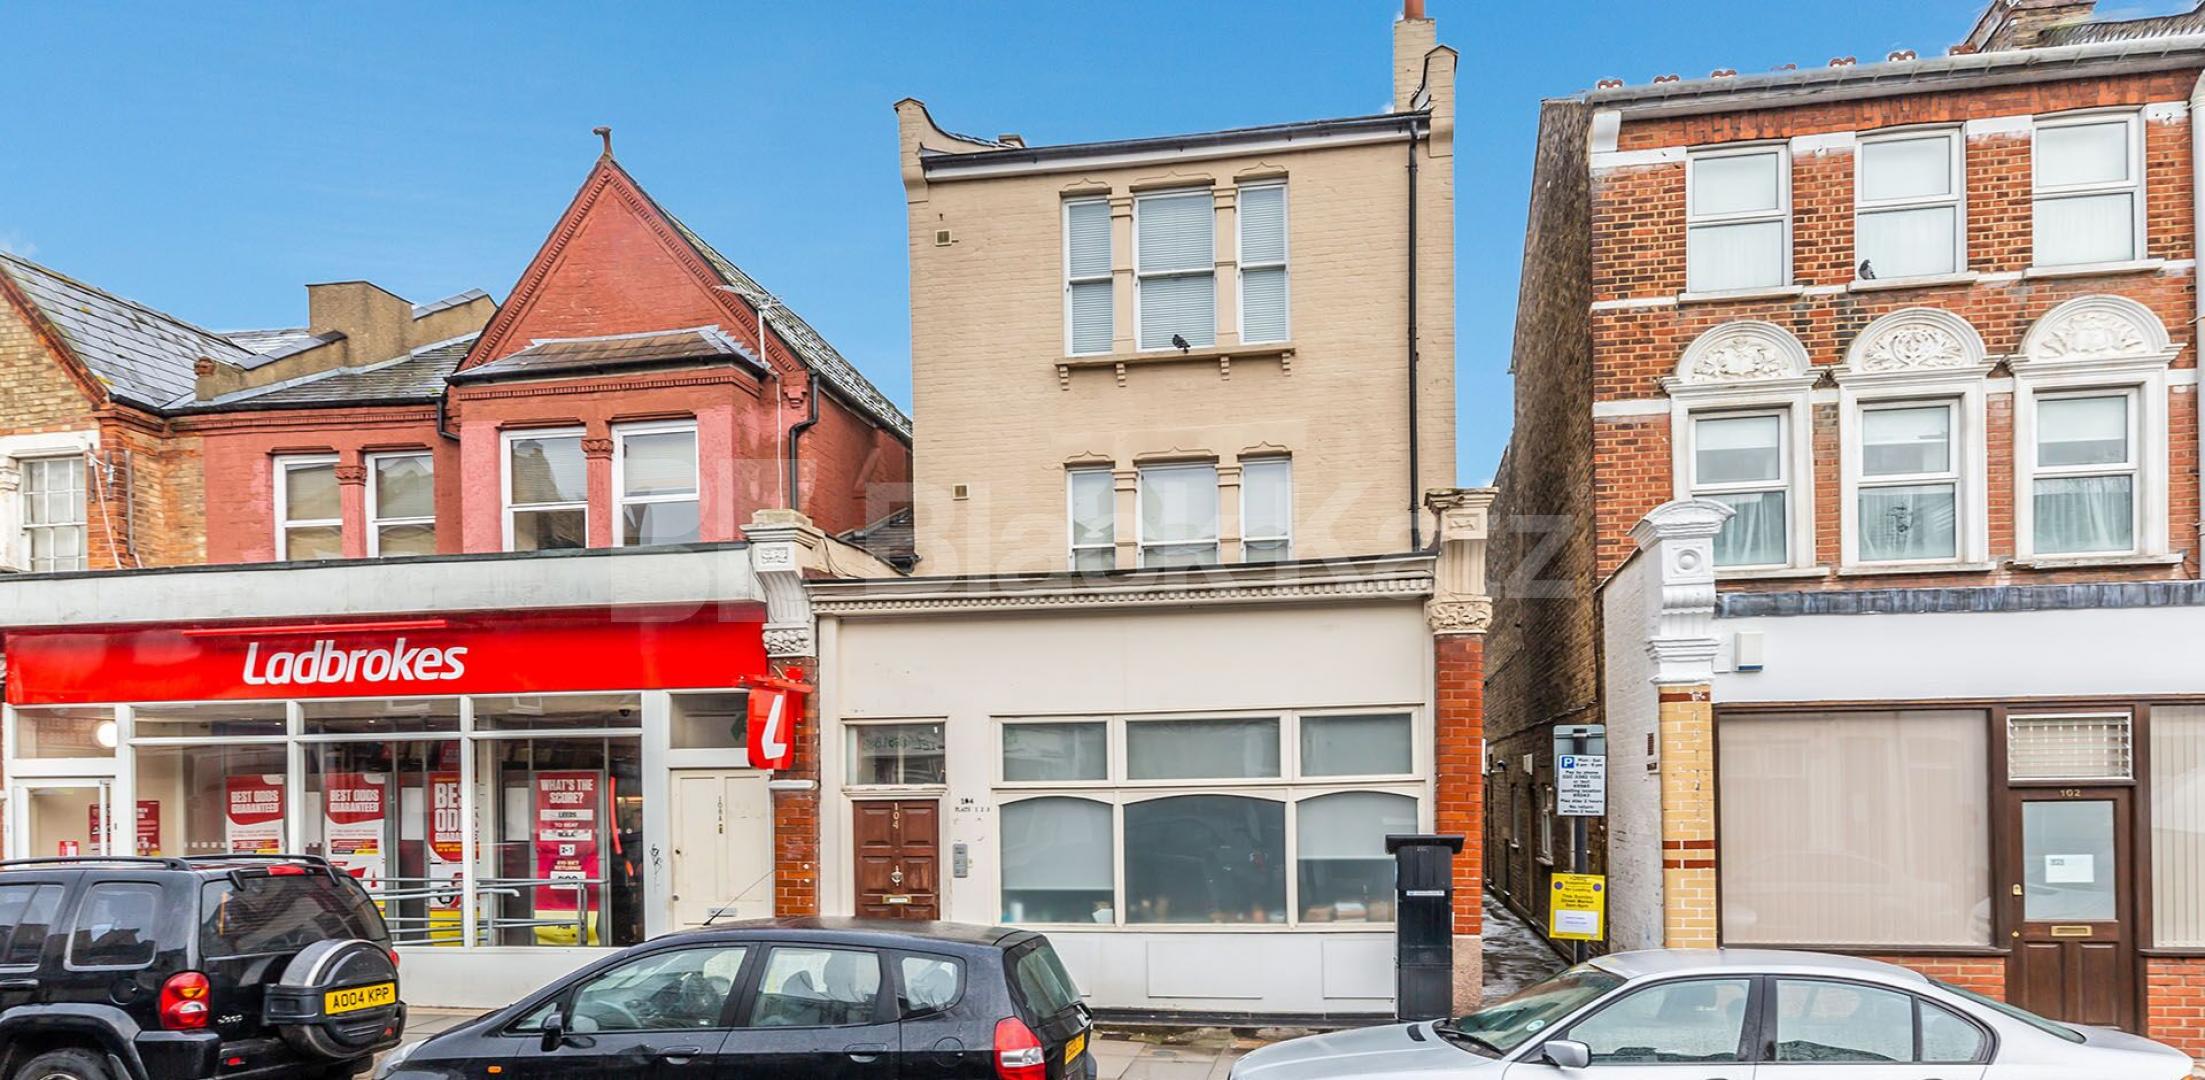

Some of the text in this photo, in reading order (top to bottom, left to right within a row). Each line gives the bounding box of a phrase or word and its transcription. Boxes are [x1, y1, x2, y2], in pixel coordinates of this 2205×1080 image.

[243, 638, 468, 685] Ladbrokes
[1563, 757, 1573, 768] P
[541, 779, 593, 791] WHAT'S THE
[231, 791, 252, 803] BEST
[329, 789, 352, 801] BEST
[434, 783, 462, 808] BE
[549, 792, 584, 804] SCORE?
[2060, 789, 2080, 797] 102
[892, 802, 900, 829] 104
[368, 986, 390, 1002] KPP
